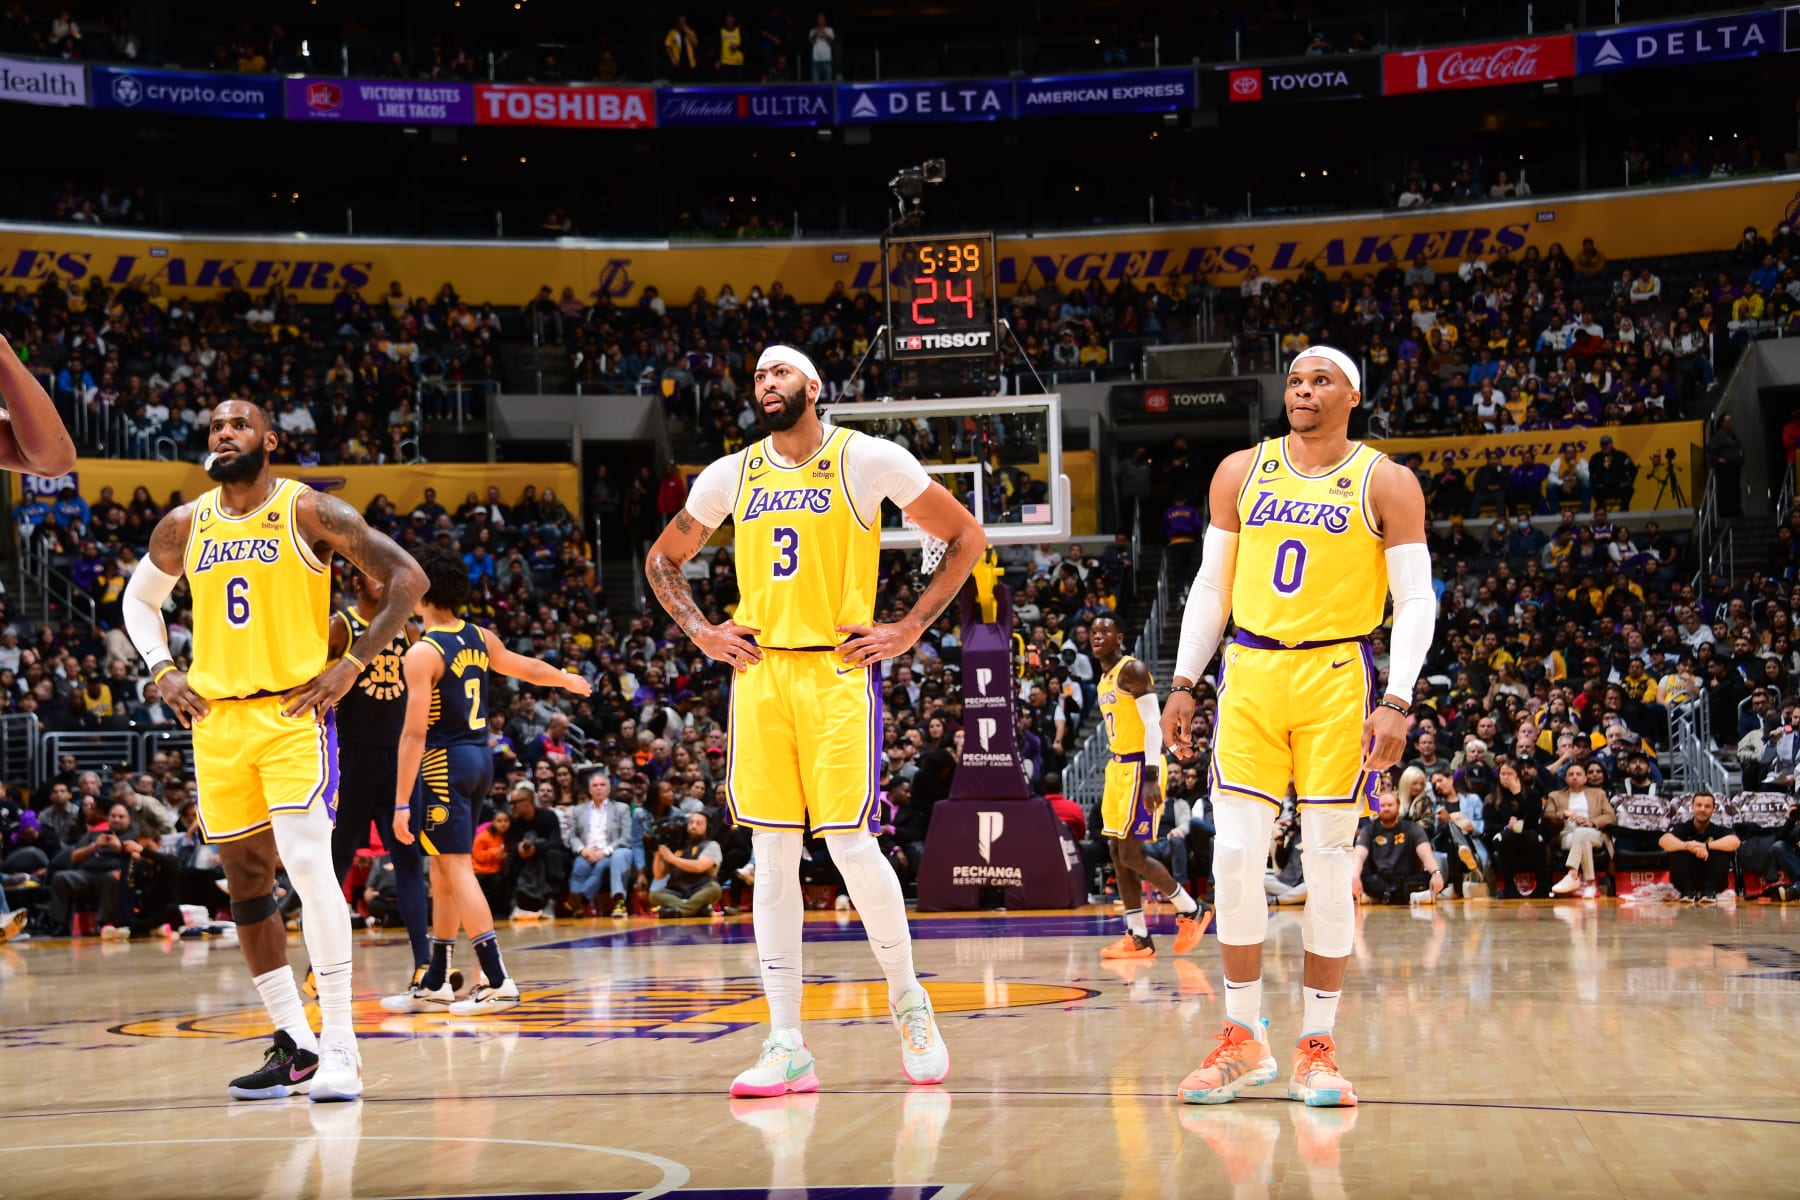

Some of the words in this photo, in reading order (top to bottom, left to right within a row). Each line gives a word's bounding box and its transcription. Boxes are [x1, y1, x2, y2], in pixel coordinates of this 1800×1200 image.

[1637, 24, 1766, 58] DELTA
[1437, 44, 1543, 84] Coca-Cola
[1268, 72, 1349, 91] TOYOTA
[146, 82, 265, 104] crypto.com
[360, 86, 415, 102] VICTORY
[416, 88, 461, 103] TASTES
[889, 90, 1001, 114] DELTA
[1026, 88, 1109, 106] AMERICAN
[1112, 84, 1185, 100] EXPRESS
[378, 104, 406, 117] LIKE
[408, 104, 446, 119] TACOS
[483, 92, 647, 122] TOSHIBA
[752, 96, 828, 116] ULTRA
[919, 243, 979, 274] 5:39
[984, 245, 1256, 284] ANGELES
[1270, 223, 1530, 270] LAKERS
[0, 250, 91, 281] ES
[108, 255, 373, 290] LAKERS
[911, 276, 974, 325] 24
[921, 332, 991, 350] TISSOT
[1172, 393, 1226, 406] TOYOTA
[811, 471, 835, 480] bibigo
[741, 486, 833, 522] LAKERS
[1328, 488, 1354, 498] bibigo
[1245, 491, 1351, 534] LAKERS
[261, 522, 284, 531] bibigo
[194, 538, 280, 574] LAKERS
[772, 526, 799, 578] 3
[1272, 538, 1308, 594] 0
[226, 576, 251, 625] 6
[370, 654, 400, 684] 33
[464, 677, 487, 731] 2
[964, 696, 1007, 705] PECHANGA
[963, 753, 1013, 762] PECHANGA
[1627, 805, 1665, 815] DELTA
[1752, 802, 1789, 811] DELTA
[952, 866, 1023, 879] PECHANGA
[952, 877, 987, 885] RESORT
